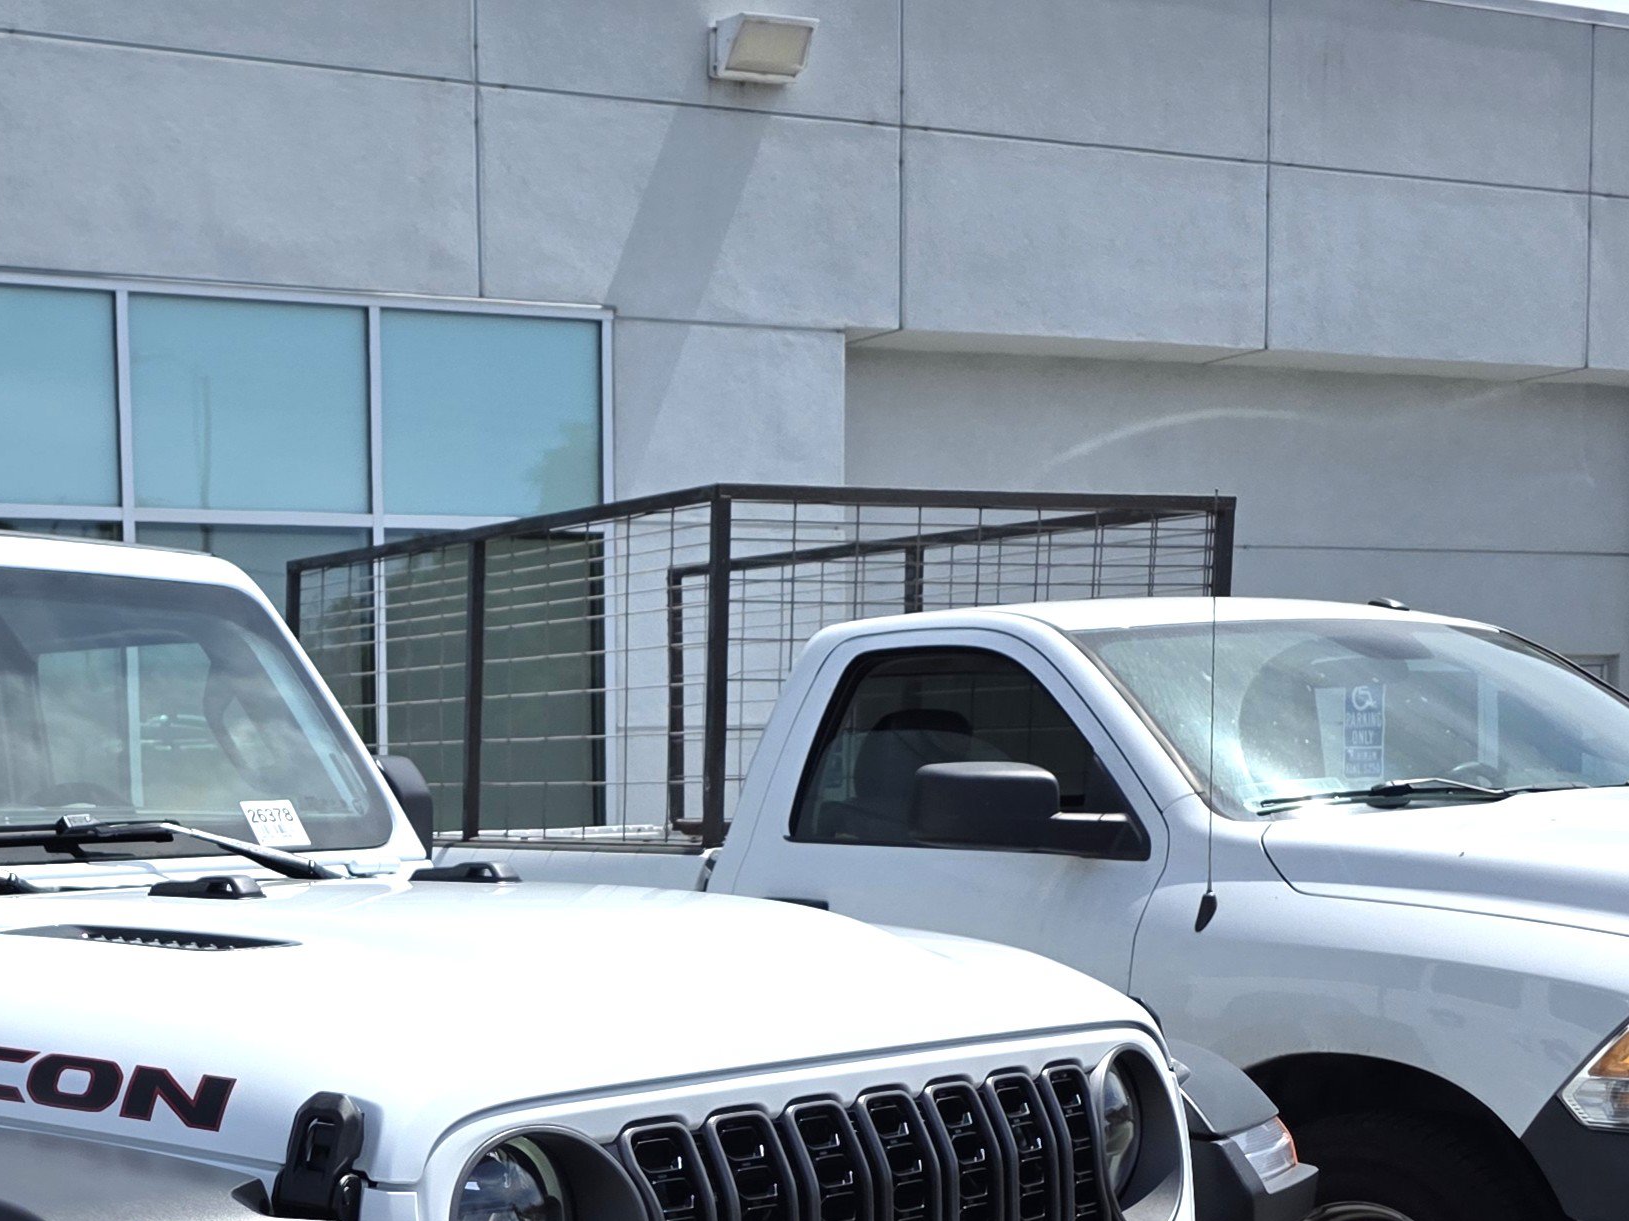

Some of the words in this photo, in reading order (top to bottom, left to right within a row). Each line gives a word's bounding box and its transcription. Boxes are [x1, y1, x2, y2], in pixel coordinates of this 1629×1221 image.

[1345, 712, 1382, 729] PARKING
[1352, 730, 1374, 745] ONLY
[248, 808, 294, 823] 26378
